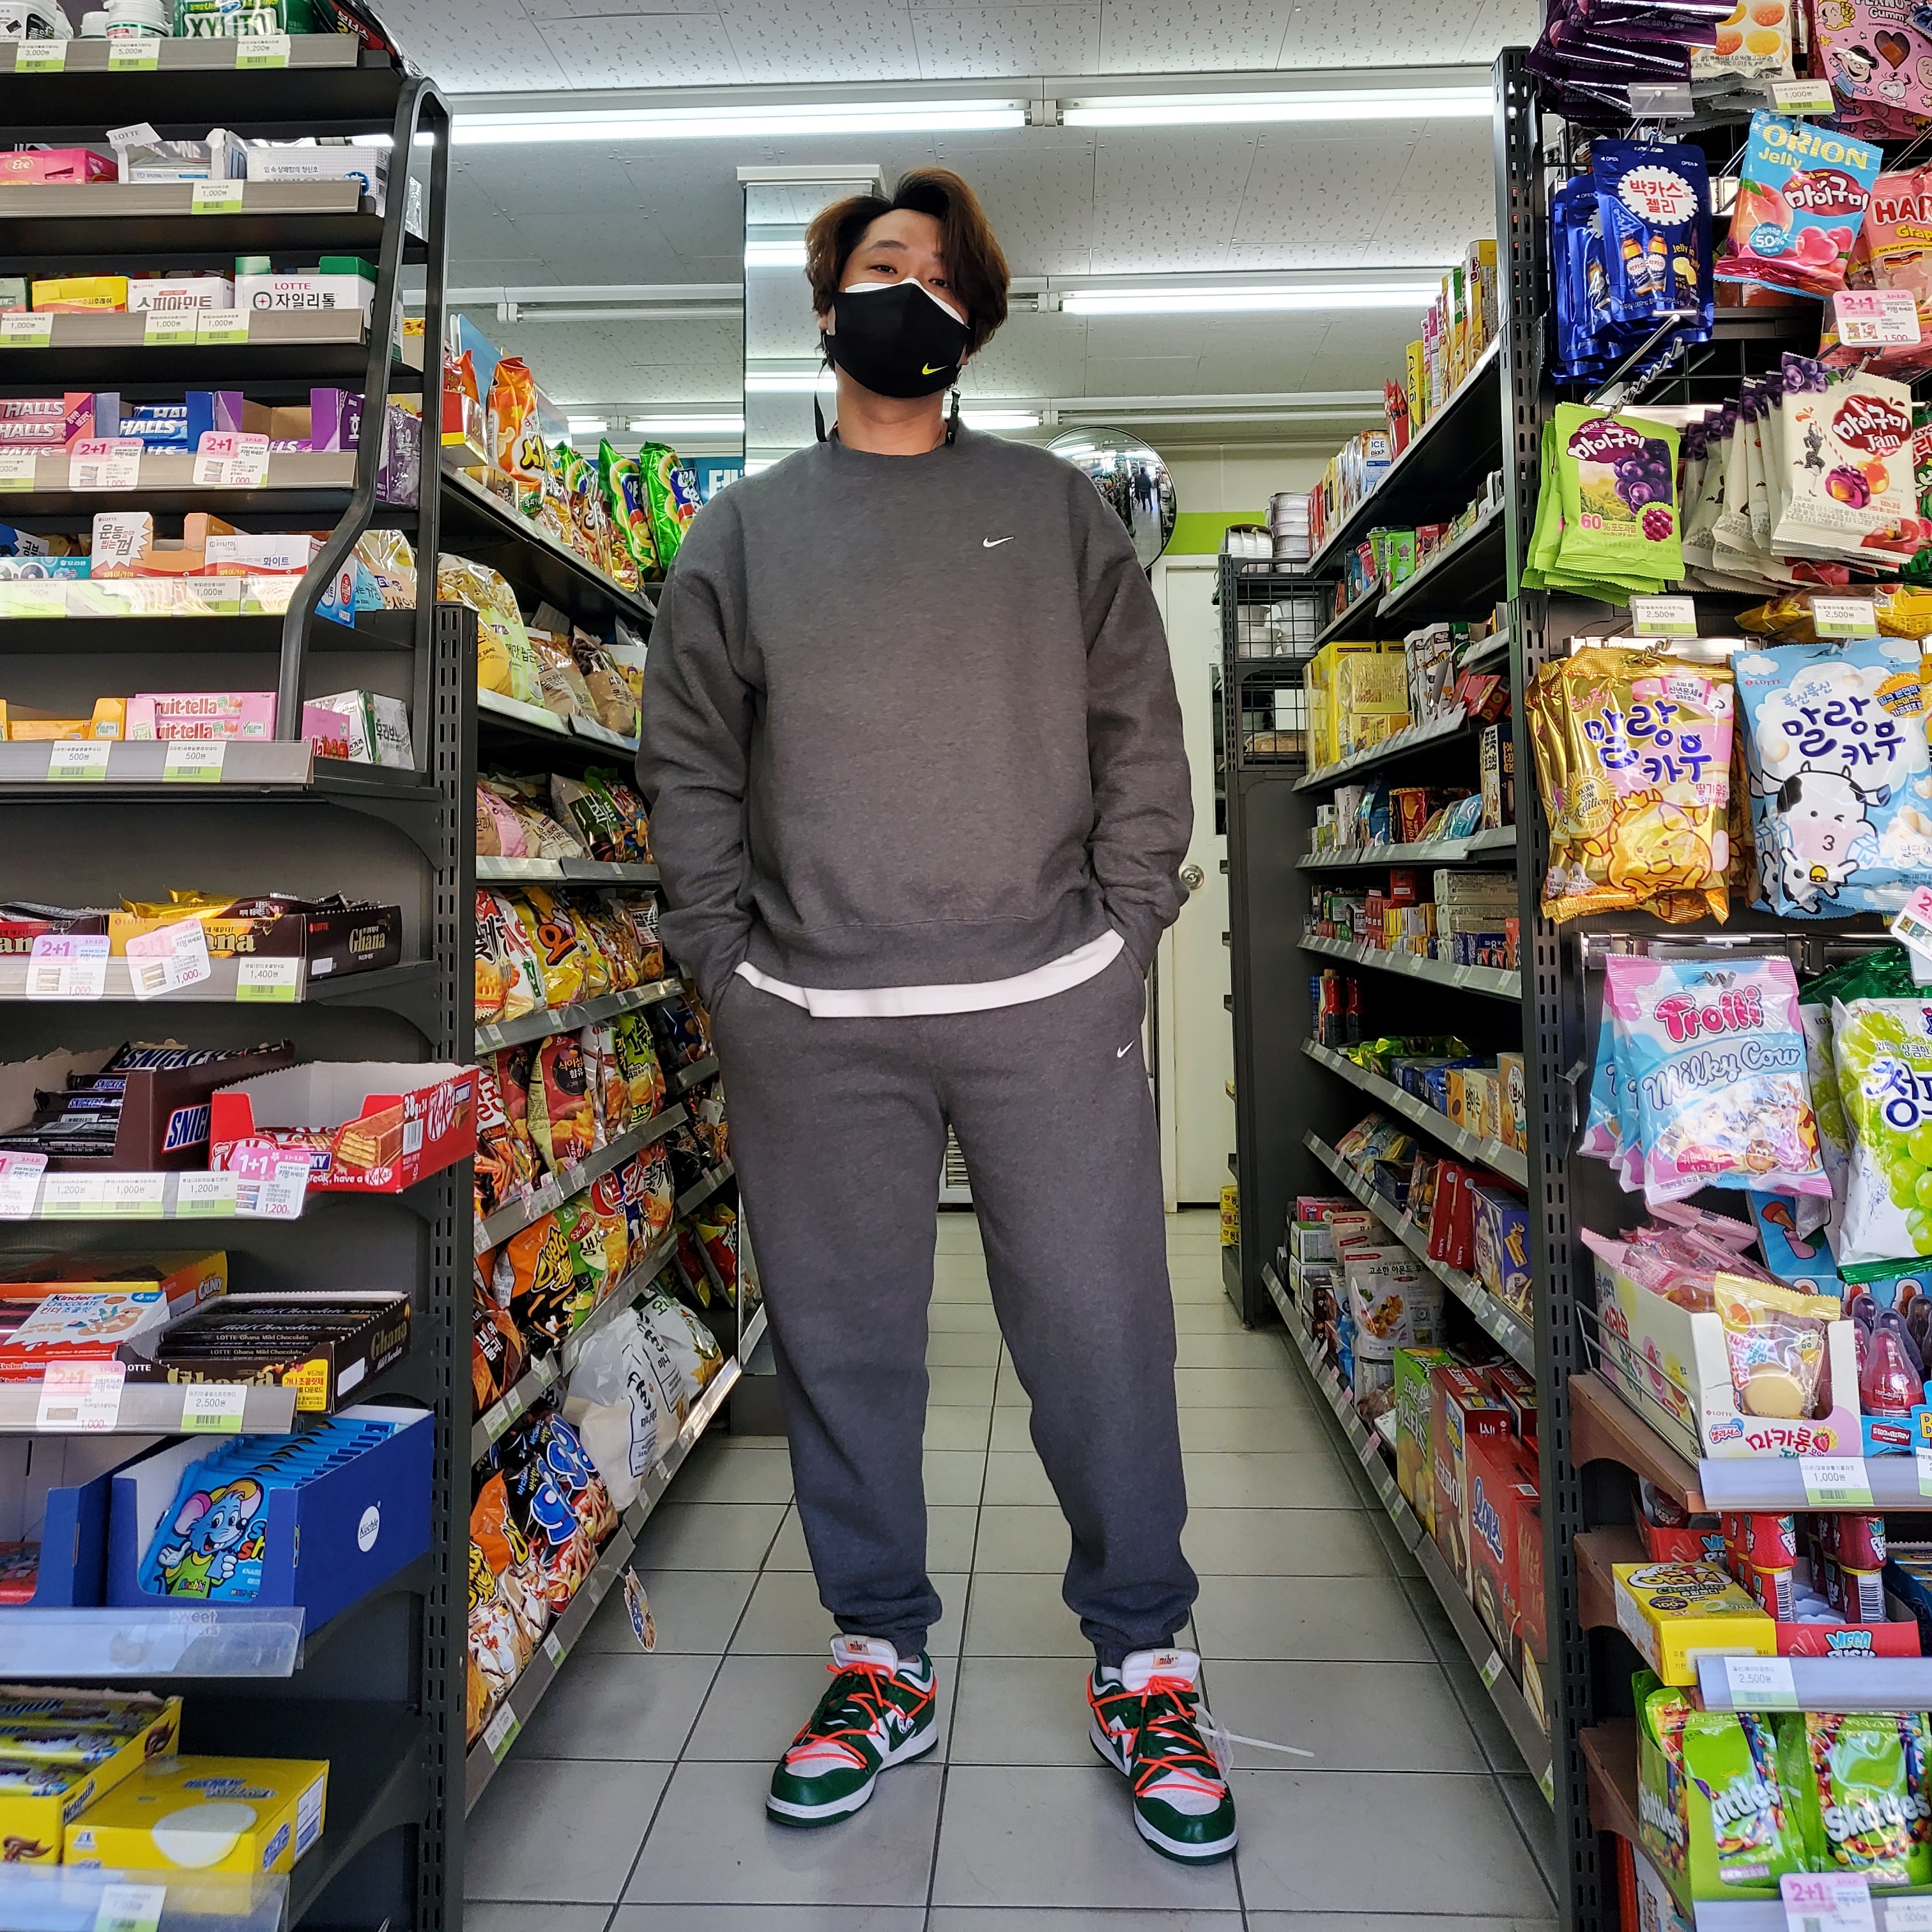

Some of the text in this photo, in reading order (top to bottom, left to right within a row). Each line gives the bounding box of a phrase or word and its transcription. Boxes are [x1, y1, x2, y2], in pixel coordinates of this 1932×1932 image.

[114, 130, 140, 140] LOTTE
[1761, 123, 1869, 170] ORION
[1758, 146, 1802, 171] Jelly
[1629, 178, 1682, 199] 박카스
[1784, 174, 1871, 212] 마이구미
[1645, 197, 1677, 215] 젤리
[1672, 243, 1695, 256] Jelly in
[1755, 235, 1786, 248] 50%
[1629, 262, 1645, 271] 박카스
[274, 282, 312, 290] LOTTE
[137, 295, 212, 311] 스피아민트
[275, 293, 336, 309] 자일리톨
[1843, 296, 1874, 310] 2+1
[208, 319, 233, 327] 1,000원
[1407, 355, 1417, 404] 고소미
[6, 401, 65, 418] HALLS
[119, 419, 176, 436] HALLS
[1832, 402, 1908, 441] 마이구미
[0, 422, 56, 439] HALLS
[80, 442, 107, 456] 2+1
[205, 438, 233, 452] 2+1
[1370, 440, 1386, 448] ICE
[1567, 428, 1646, 460] 마이구미
[1864, 434, 1901, 452] Jam
[1370, 448, 1386, 457] Black
[105, 479, 126, 488] 1,000
[229, 476, 250, 485] 1,000
[1581, 512, 1637, 533] 60 % 포도과즙
[98, 524, 123, 540] 운동
[116, 537, 132, 556] 껌
[263, 556, 290, 567] 화이트
[1646, 610, 1676, 618] 2,500원
[1825, 610, 1855, 618] 2,500원
[1872, 673, 1897, 696] Upgrade
[1781, 680, 1834, 709] 폭신폭신
[1781, 695, 1872, 758] 말랑
[1581, 700, 1680, 770] 말랑
[1841, 719, 1907, 766] 카우
[185, 752, 206, 760] 500원
[1641, 732, 1713, 785] 카우
[1575, 783, 1595, 798] GOLDEN
[1580, 791, 1595, 802] COW
[1575, 796, 1611, 819] Edition
[349, 925, 386, 954] Ghana
[40, 940, 71, 957] 2+1
[176, 969, 199, 984] 1,000
[250, 970, 279, 979] 1,400원
[68, 986, 91, 995] 1,000
[1653, 985, 1766, 1044] Trolli
[1643, 1041, 1801, 1112] Milky Cow
[1465, 1087, 1481, 1116] 엄마손
[238, 1154, 268, 1174] 1+1
[278, 1169, 290, 1179] 키핑
[333, 1174, 355, 1183] have
[365, 1167, 393, 1186] KitKat
[56, 1186, 86, 1195] 1,200원
[116, 1185, 145, 1194] 1,000원
[190, 1184, 219, 1193] 1,200원
[264, 1202, 288, 1215] 1,200
[1368, 1265, 1413, 1275] 고소한 아몬드
[197, 1277, 224, 1300] CRUNKY
[369, 1319, 408, 1361] Ghana
[195, 1398, 226, 1407] 2,500원
[80, 1420, 105, 1429] 1,000
[1711, 1429, 1741, 1442] 젤리셔스
[1745, 1426, 1812, 1453] 마카롱
[1873, 1427, 1910, 1440] STRAWBERRY
[1813, 1472, 1846, 1482] 1,000원
[359, 1518, 379, 1539] Küchle
[1473, 1476, 1505, 1565] 오예스
[178, 1577, 206, 1593] Knabbi
[1641, 1570, 1722, 1586] 아이셔
[1657, 1584, 1726, 1595] Chewing
[1655, 1600, 1686, 1609] 100%
[1825, 1630, 1873, 1650] MEGA
[1158, 1655, 1175, 1666] nike
[1738, 1673, 1772, 1684] 2,500원
[1639, 1784, 1685, 1848] Skittles
[1823, 1791, 1932, 1844] Skittles
[1790, 1882, 1825, 1902] 2+1
